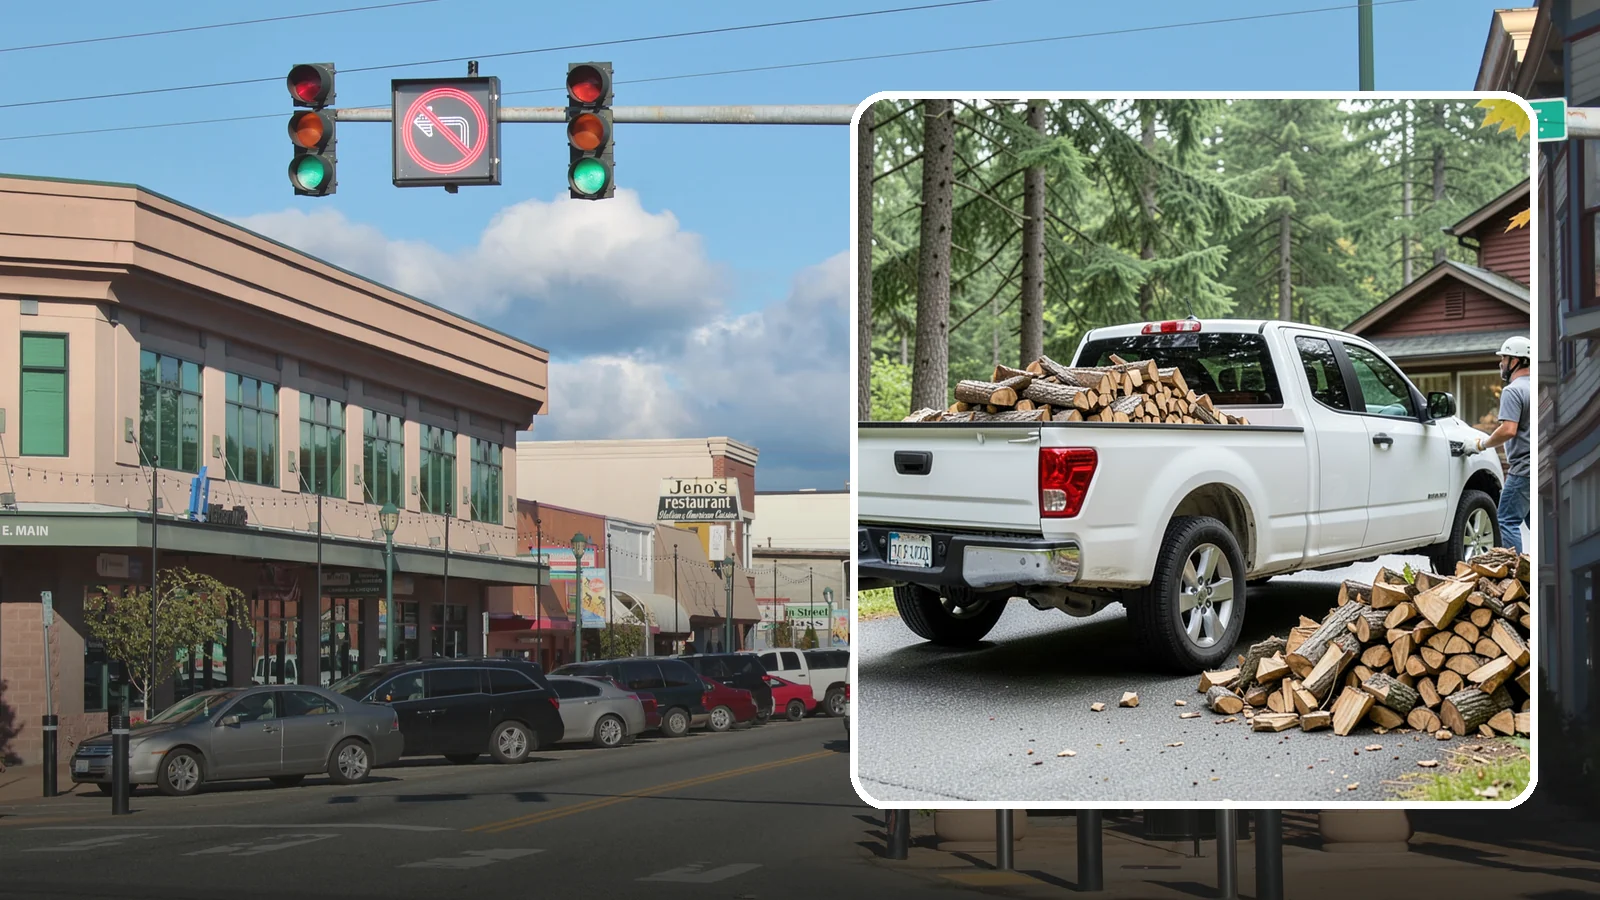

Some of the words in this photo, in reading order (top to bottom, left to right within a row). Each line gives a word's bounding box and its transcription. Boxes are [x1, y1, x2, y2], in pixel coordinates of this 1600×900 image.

[670, 480, 727, 495] Jeno's
[665, 496, 731, 509] restaurant
[659, 509, 682, 519] Italian
[686, 509, 715, 519] American
[715, 509, 737, 519] Cuisine
[2, 525, 13, 536] E.
[15, 525, 49, 536] MAIN
[797, 607, 828, 617] Street
